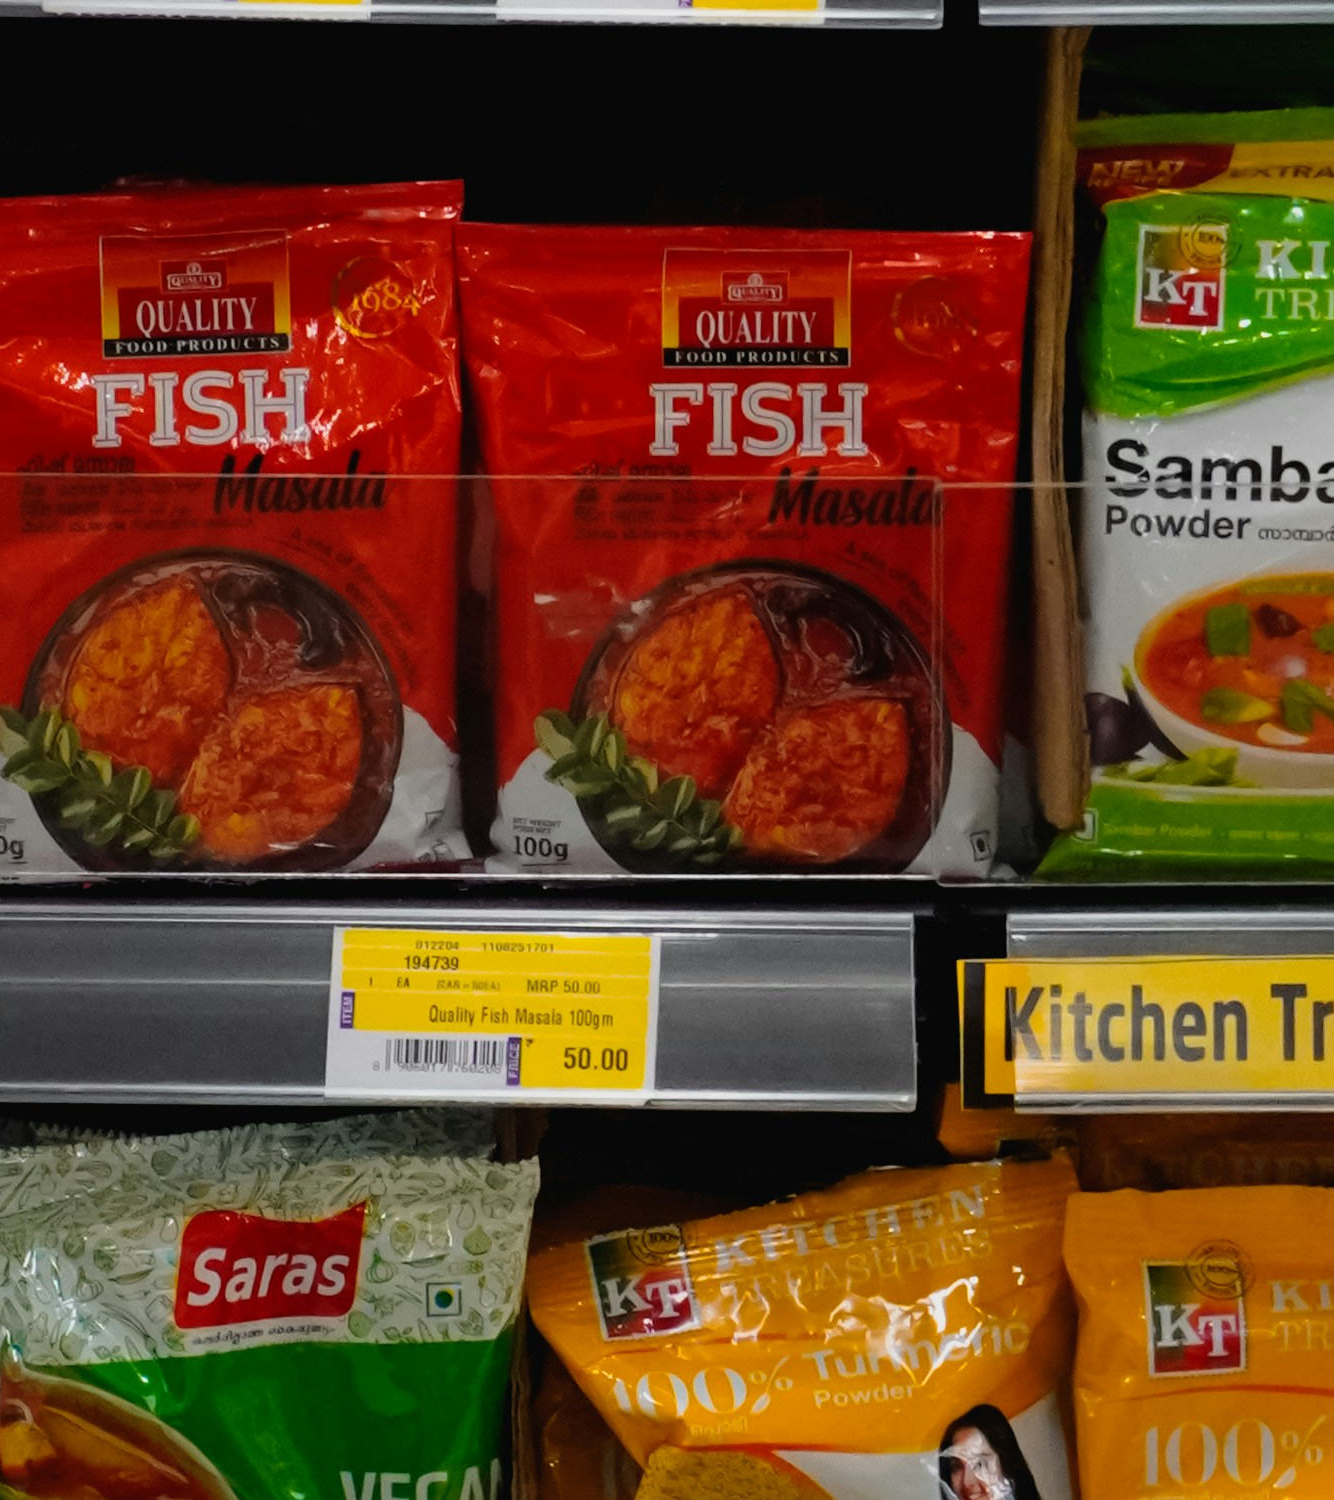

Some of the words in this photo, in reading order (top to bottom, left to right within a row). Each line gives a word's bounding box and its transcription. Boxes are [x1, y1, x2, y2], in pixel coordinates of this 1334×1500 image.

[136, 298, 257, 336] QUALITY
[350, 278, 421, 314] 1984
[91, 367, 310, 447] FISH
[649, 381, 869, 457] FISH
[213, 451, 388, 514] Masala
[1105, 508, 1251, 540] Powder
[513, 833, 567, 861] 100g
[404, 956, 459, 970] 194739
[1005, 984, 1249, 1062] Kitchen
[564, 1048, 628, 1071] 50.00
[185, 1246, 350, 1310] Saras
[1144, 1415, 1323, 1489] 100%
